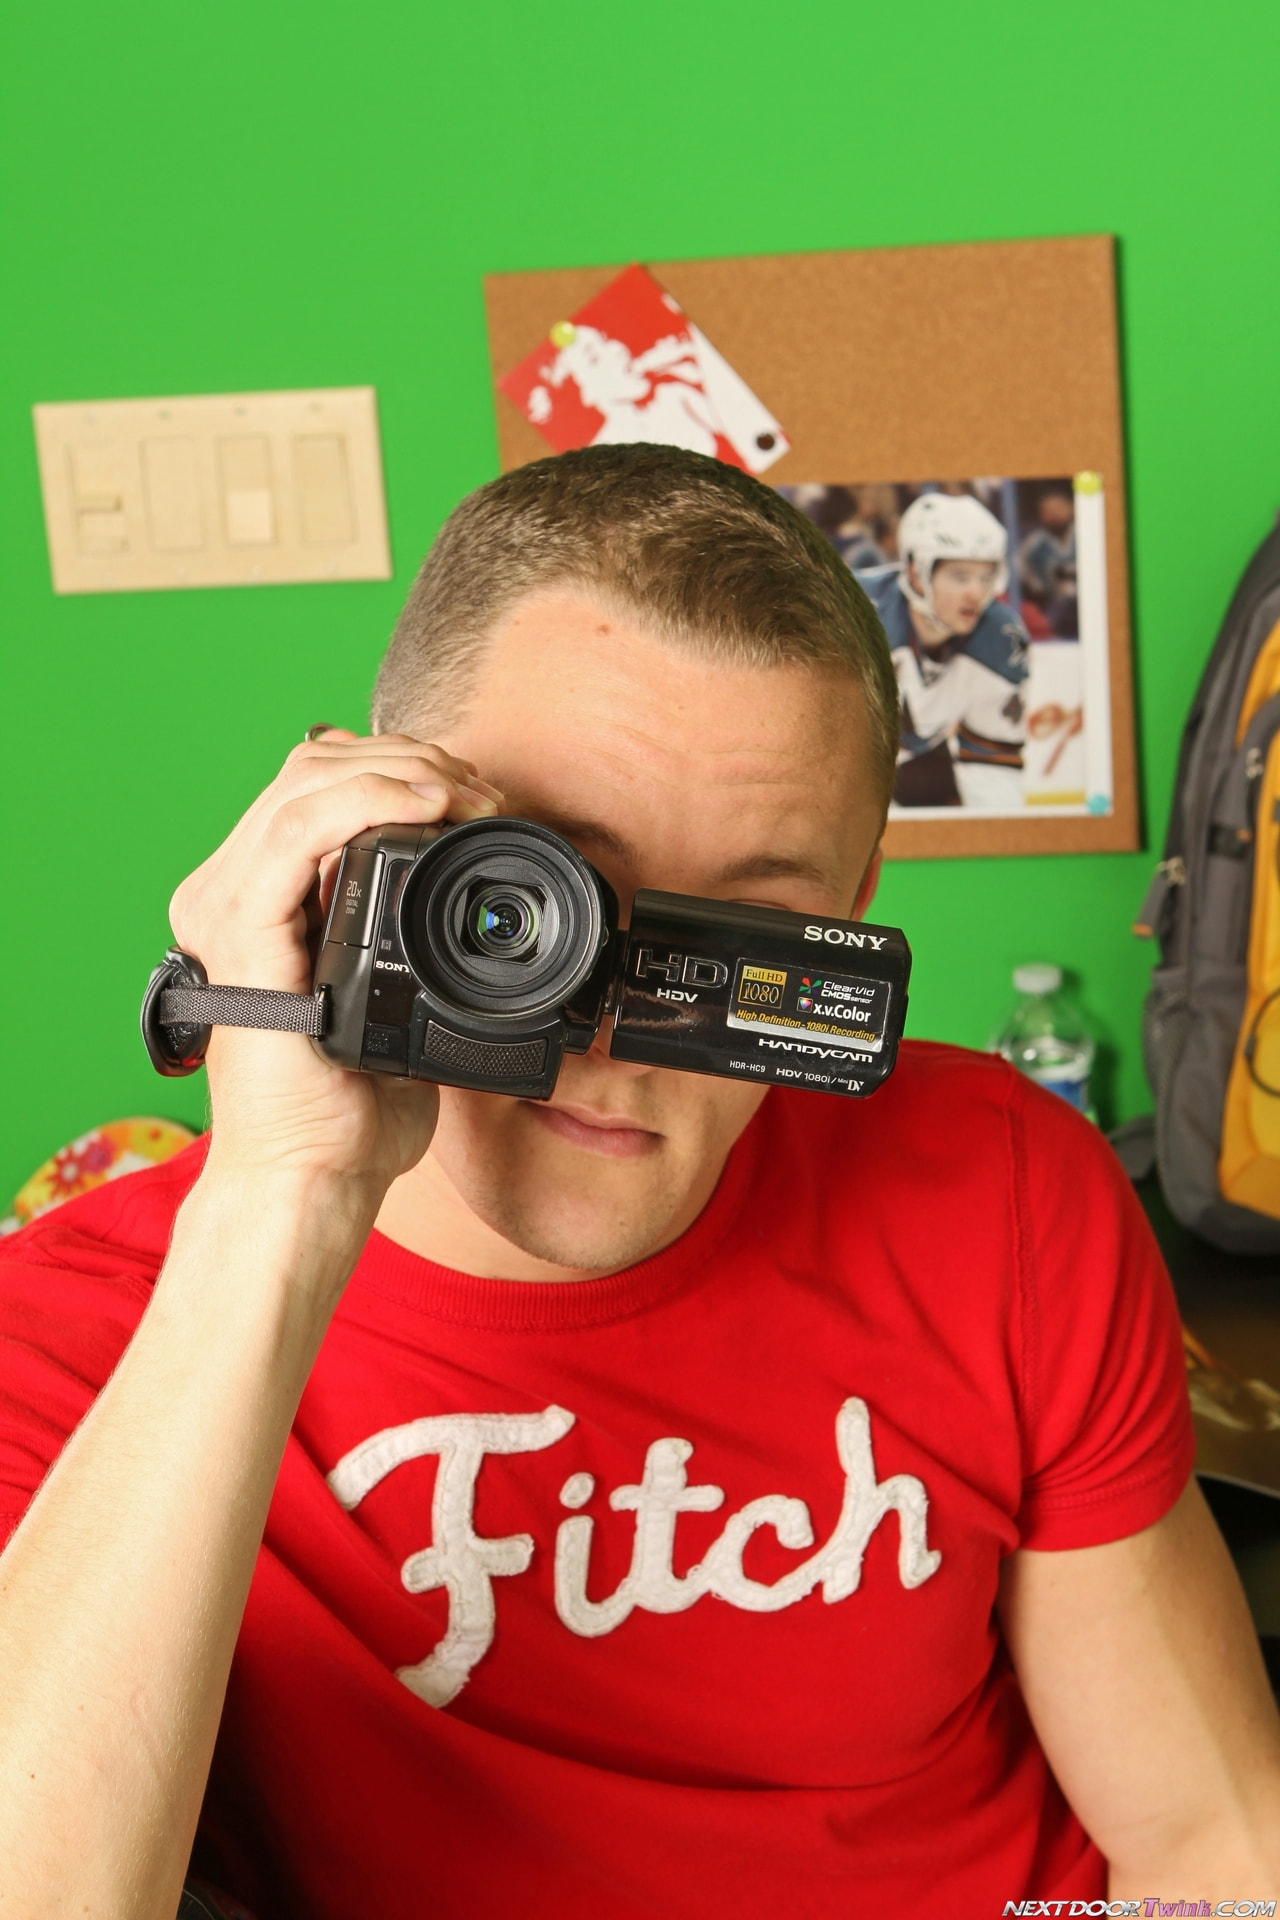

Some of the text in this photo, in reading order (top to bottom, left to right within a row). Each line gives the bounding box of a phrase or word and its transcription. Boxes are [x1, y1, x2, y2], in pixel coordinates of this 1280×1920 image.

[346, 880, 362, 898] 20x
[803, 925, 888, 951] SONY
[635, 948, 729, 989] HD
[746, 968, 784, 983] Full HD
[656, 987, 699, 1004] HDV
[741, 982, 780, 1004] 1080
[823, 981, 876, 997] ClearVid
[813, 1003, 872, 1024] x.v.Color
[736, 1009, 758, 1023] High
[758, 1012, 801, 1029] Definition
[806, 1021, 829, 1034] 1080i
[829, 1025, 876, 1042] Recording
[729, 1060, 767, 1074] HDR-HC9
[775, 1067, 802, 1080] HDV
[327, 1396, 942, 1708] Fitch
